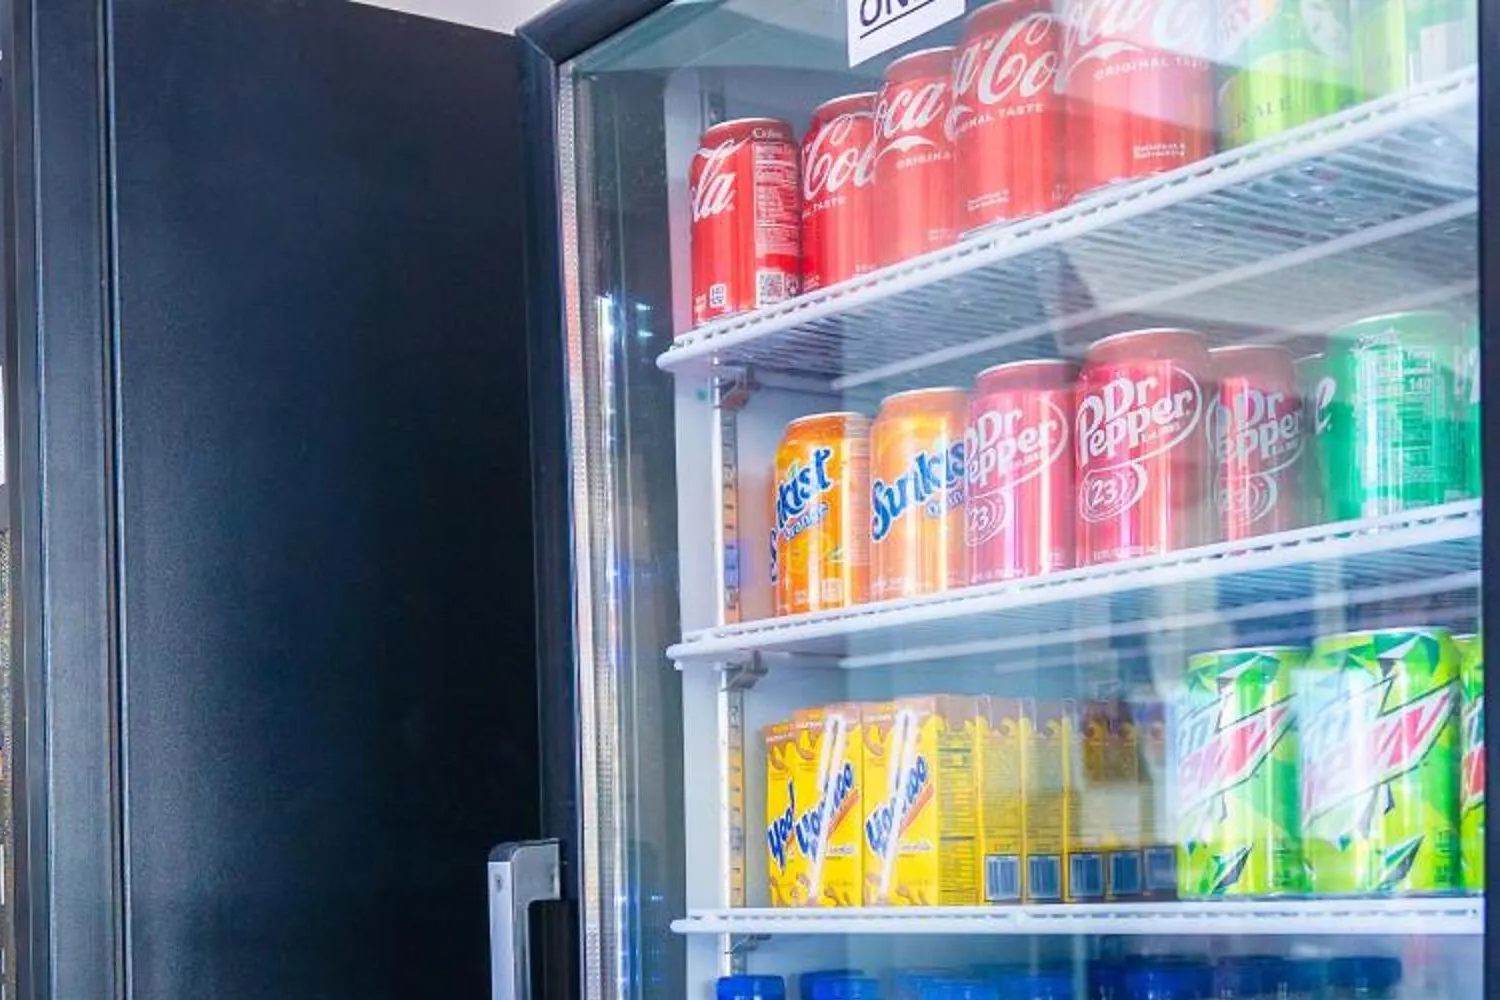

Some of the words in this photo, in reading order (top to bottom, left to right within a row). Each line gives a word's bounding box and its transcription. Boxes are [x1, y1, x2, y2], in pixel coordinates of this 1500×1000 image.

[1000, 103, 1044, 117] TASTE
[1103, 375, 1157, 421] Dr
[1233, 389, 1284, 422] Dr
[977, 409, 1023, 446] Dr
[1077, 391, 1190, 465] Pepper
[964, 420, 1058, 488] Pepper
[1091, 482, 1117, 505] 23
